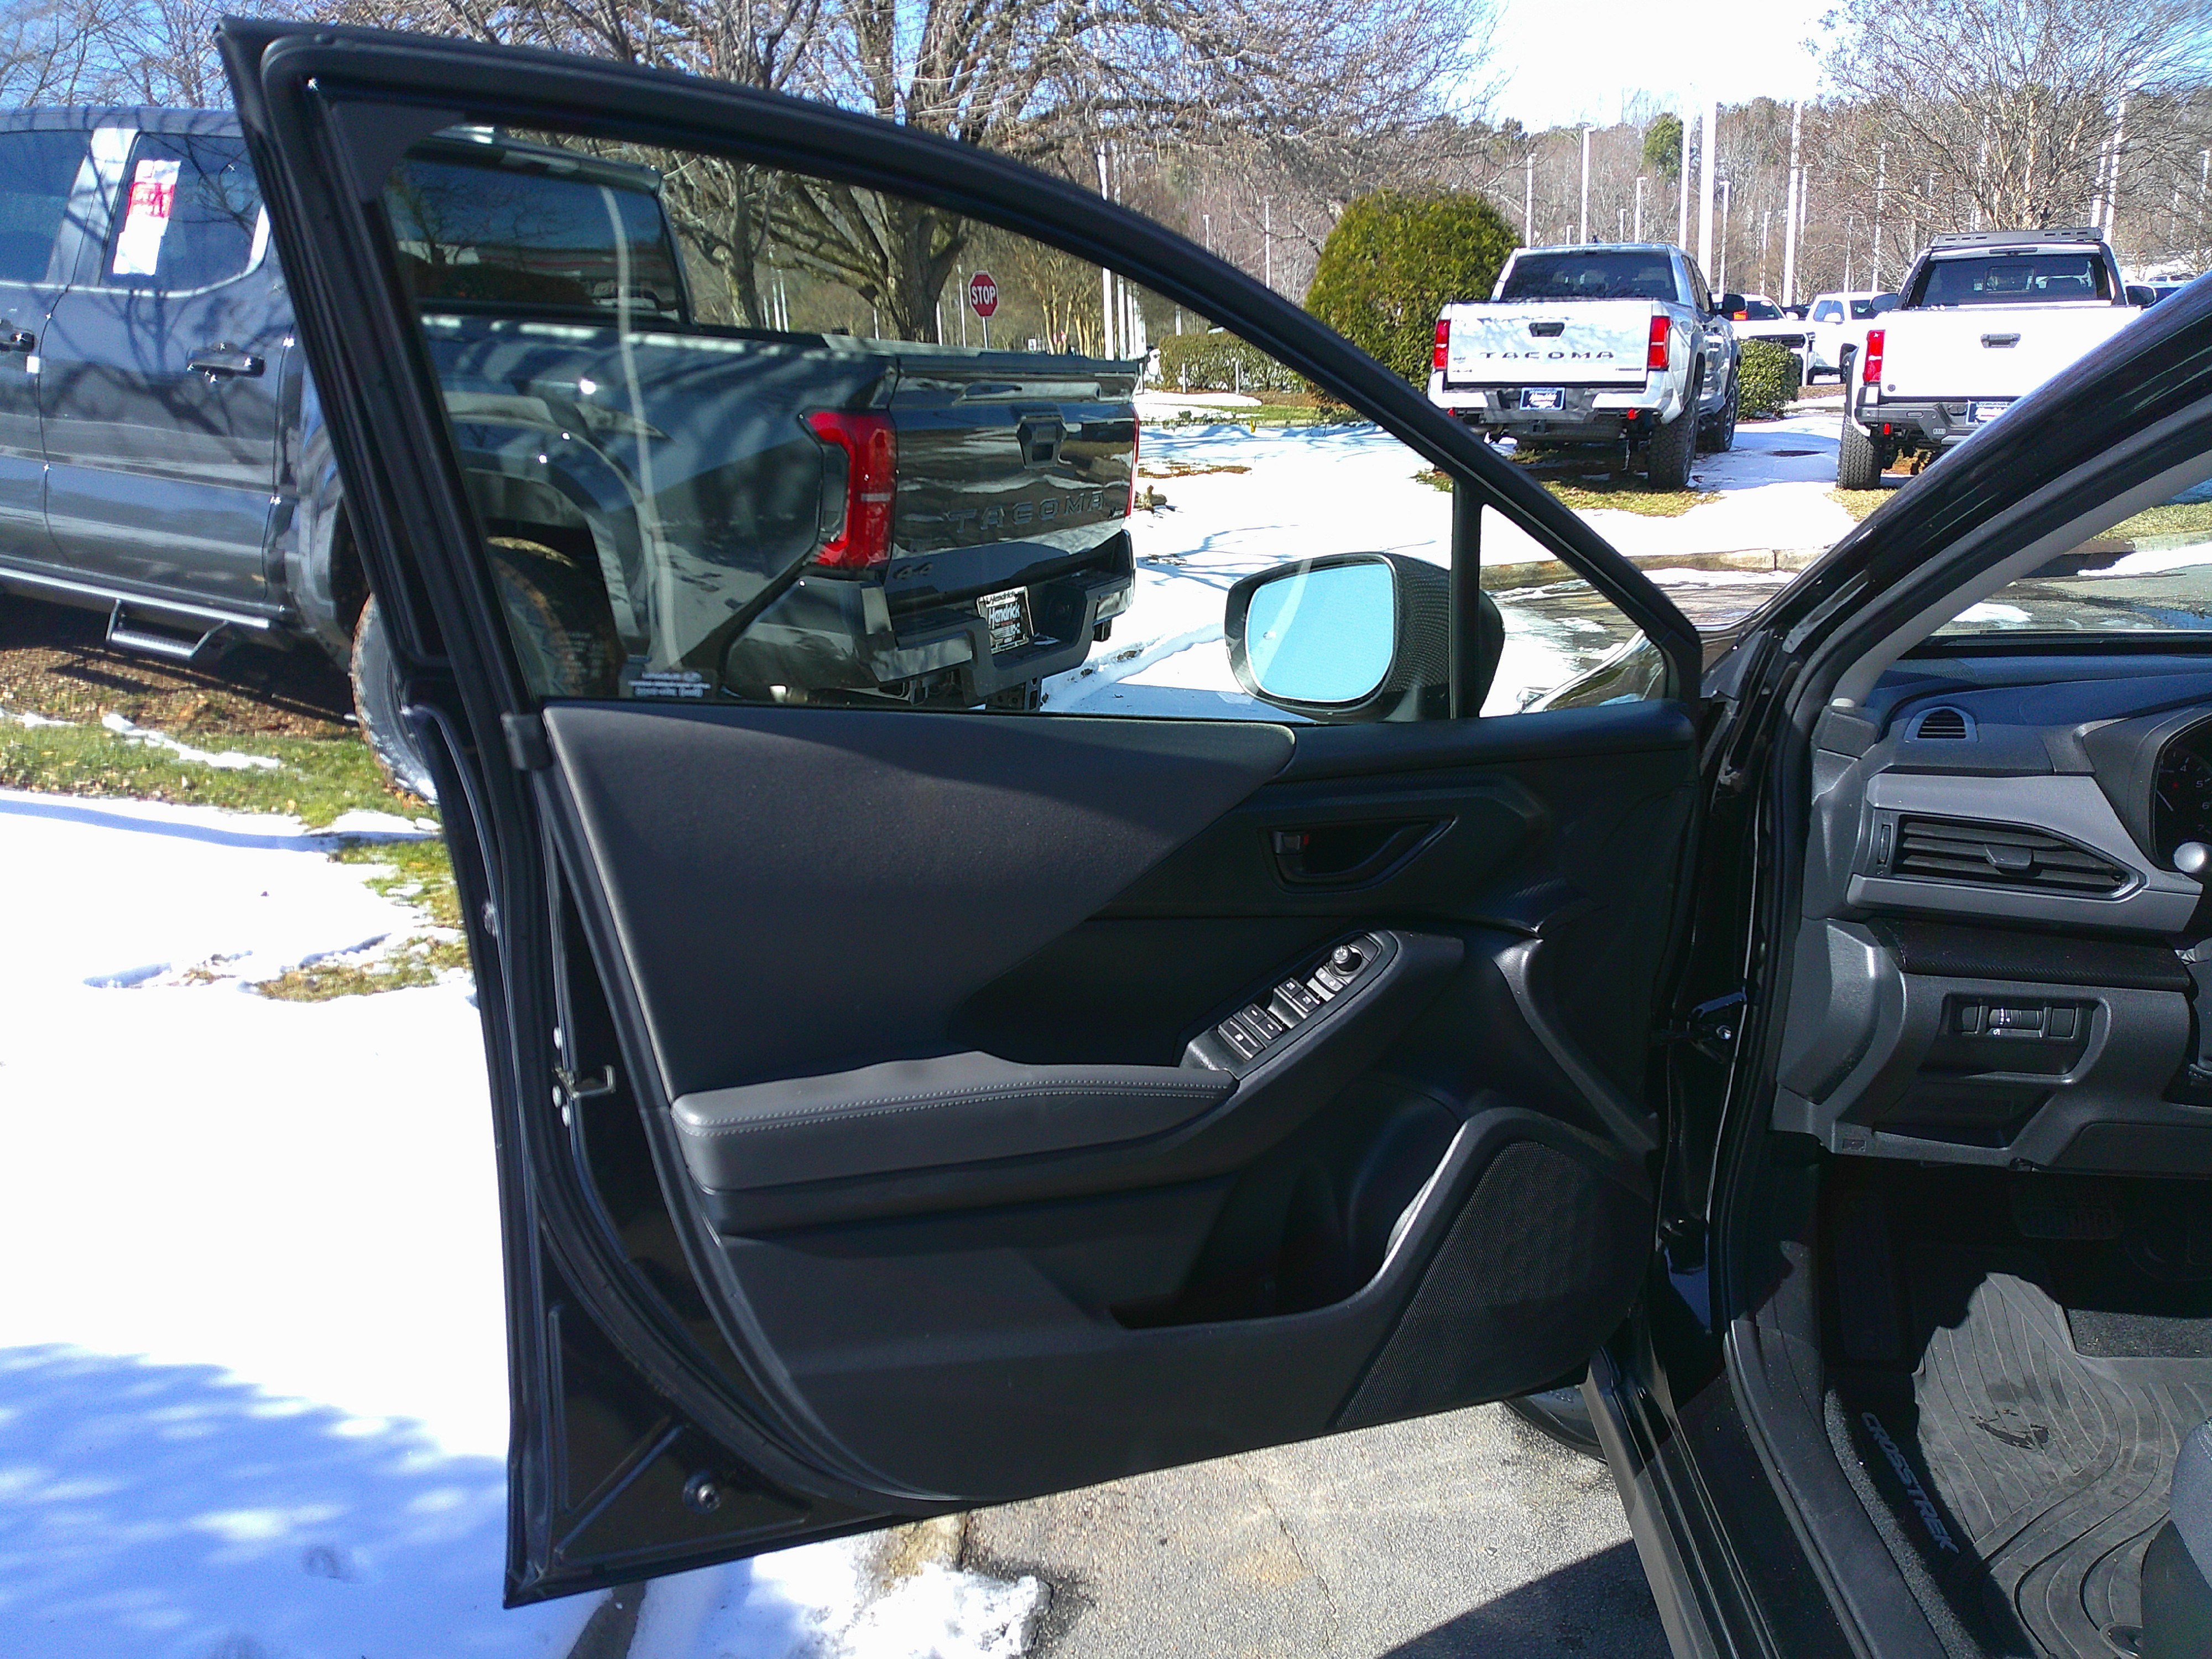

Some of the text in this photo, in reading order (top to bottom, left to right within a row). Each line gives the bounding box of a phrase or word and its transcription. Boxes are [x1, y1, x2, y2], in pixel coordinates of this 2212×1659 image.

[972, 285, 995, 305] STOP
[946, 491, 1104, 533] TACOMA
[988, 602, 1020, 629] Hendrick
[1861, 1412, 1959, 1554] CROSSTREK
